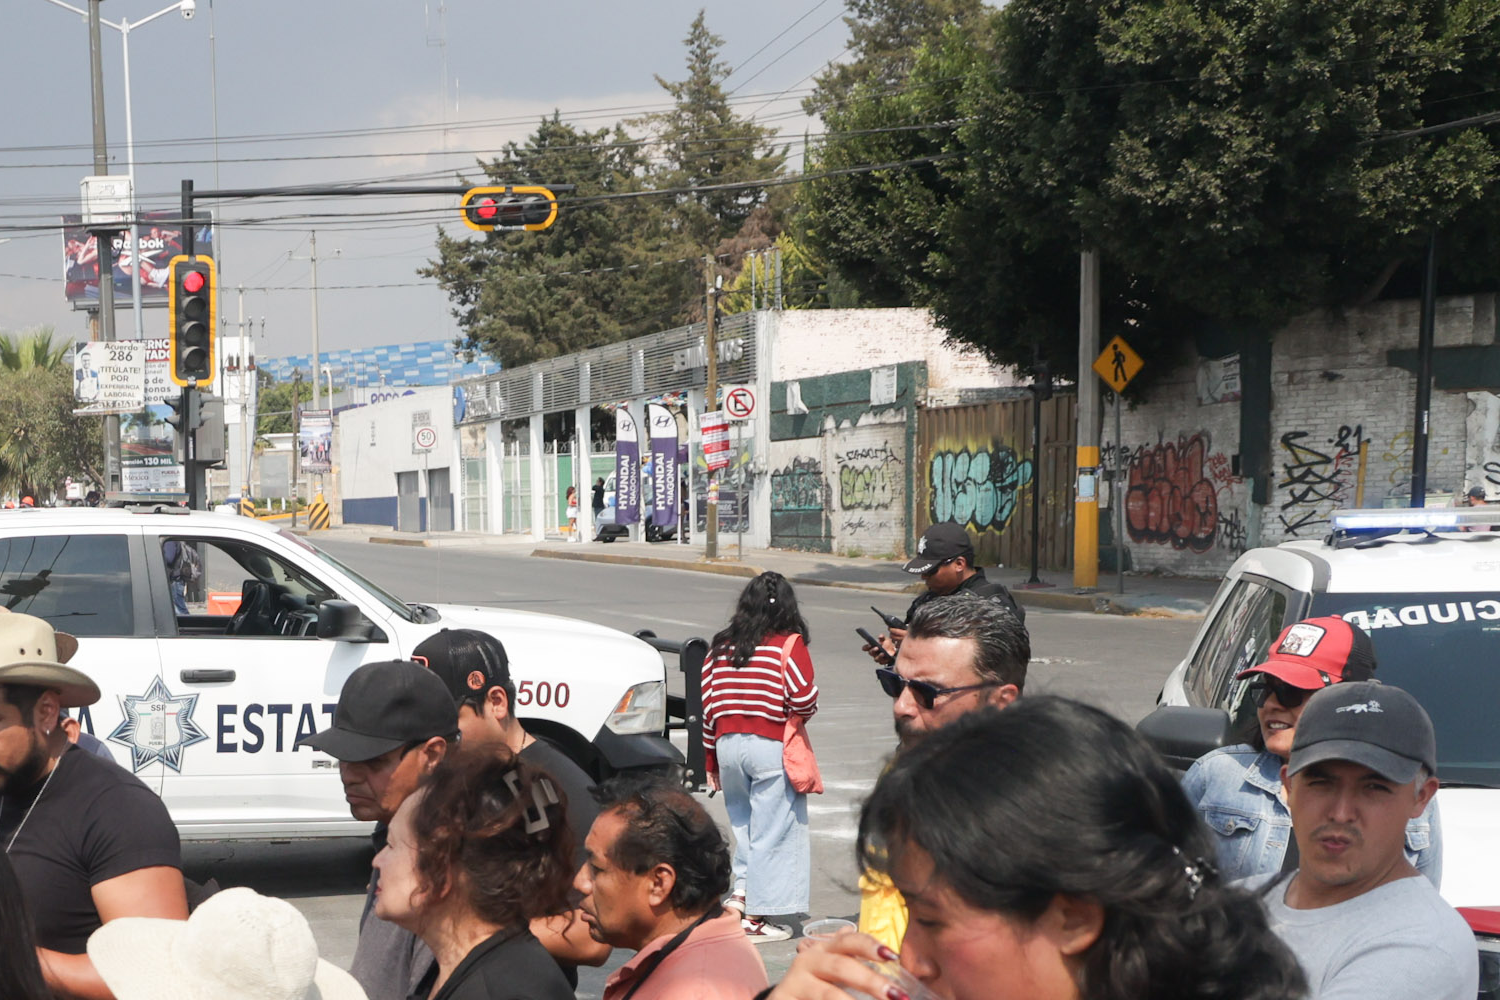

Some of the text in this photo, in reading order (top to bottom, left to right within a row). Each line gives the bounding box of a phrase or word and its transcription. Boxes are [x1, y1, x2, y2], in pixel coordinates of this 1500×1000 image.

[113, 238, 164, 249] Rebok
[104, 343, 138, 351] Acuerdo
[109, 350, 133, 361] 286
[145, 349, 170, 360] TAD
[421, 431, 432, 441] 50
[143, 457, 159, 465] 130
[618, 455, 630, 510] HYUNDAI
[629, 461, 637, 506] DIAGONAL
[656, 452, 665, 511] HYUNDAI
[517, 680, 570, 708] 500
